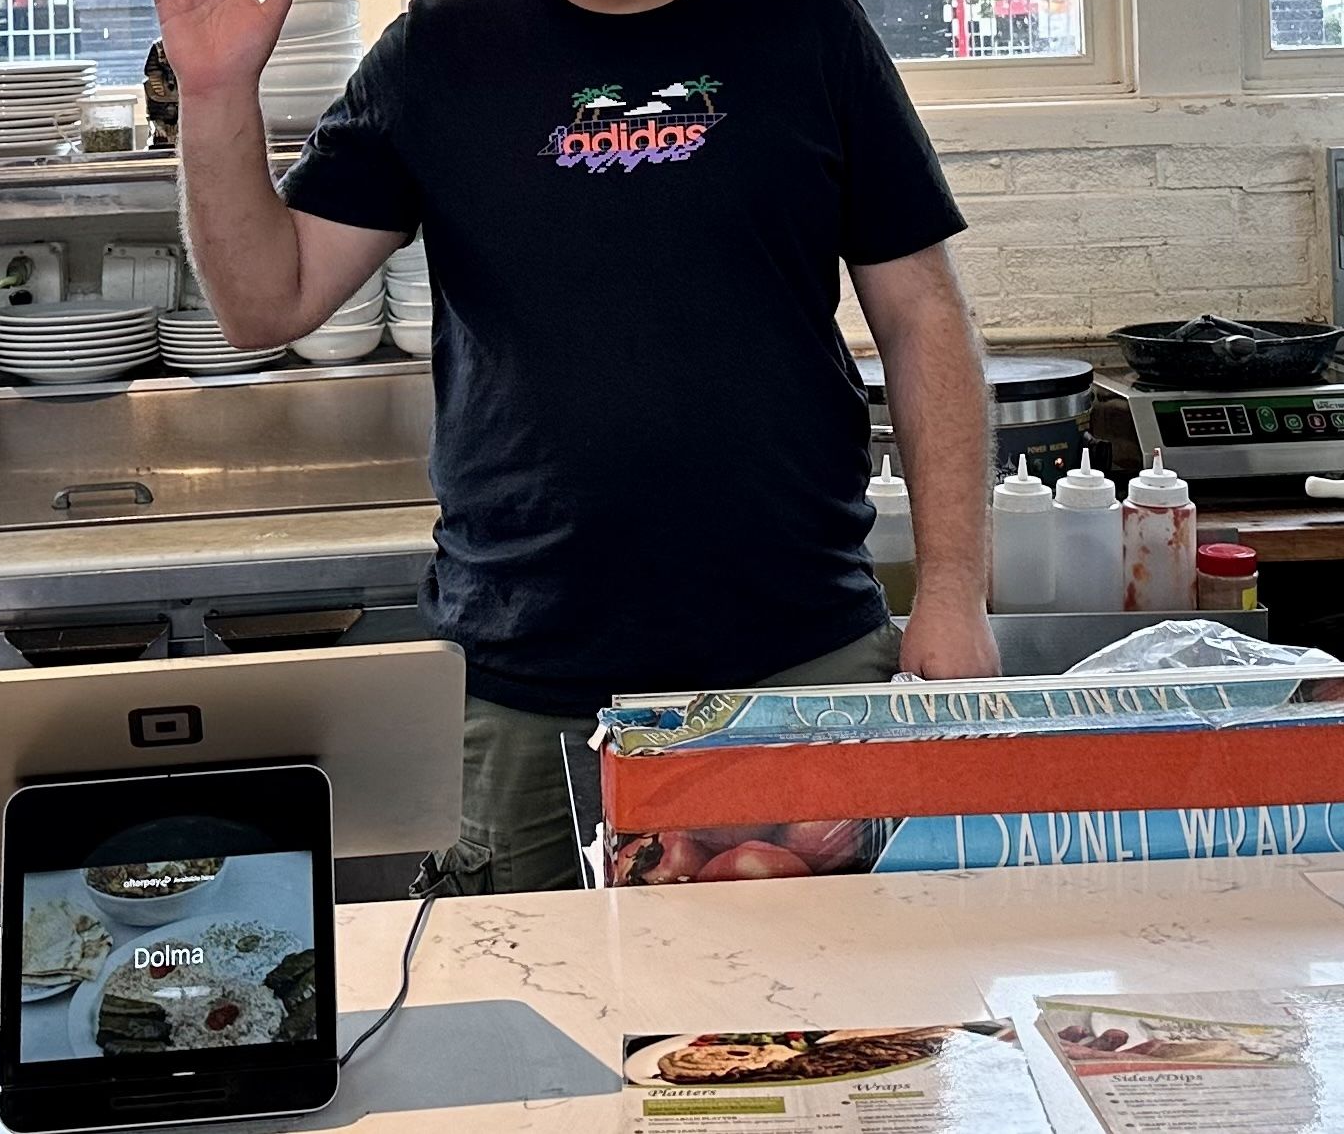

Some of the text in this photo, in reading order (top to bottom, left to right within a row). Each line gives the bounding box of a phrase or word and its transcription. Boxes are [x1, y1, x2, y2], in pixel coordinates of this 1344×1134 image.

[563, 119, 708, 155] adidas
[134, 945, 204, 969] Dolma
[648, 1082, 911, 1097] Platters Wraps
